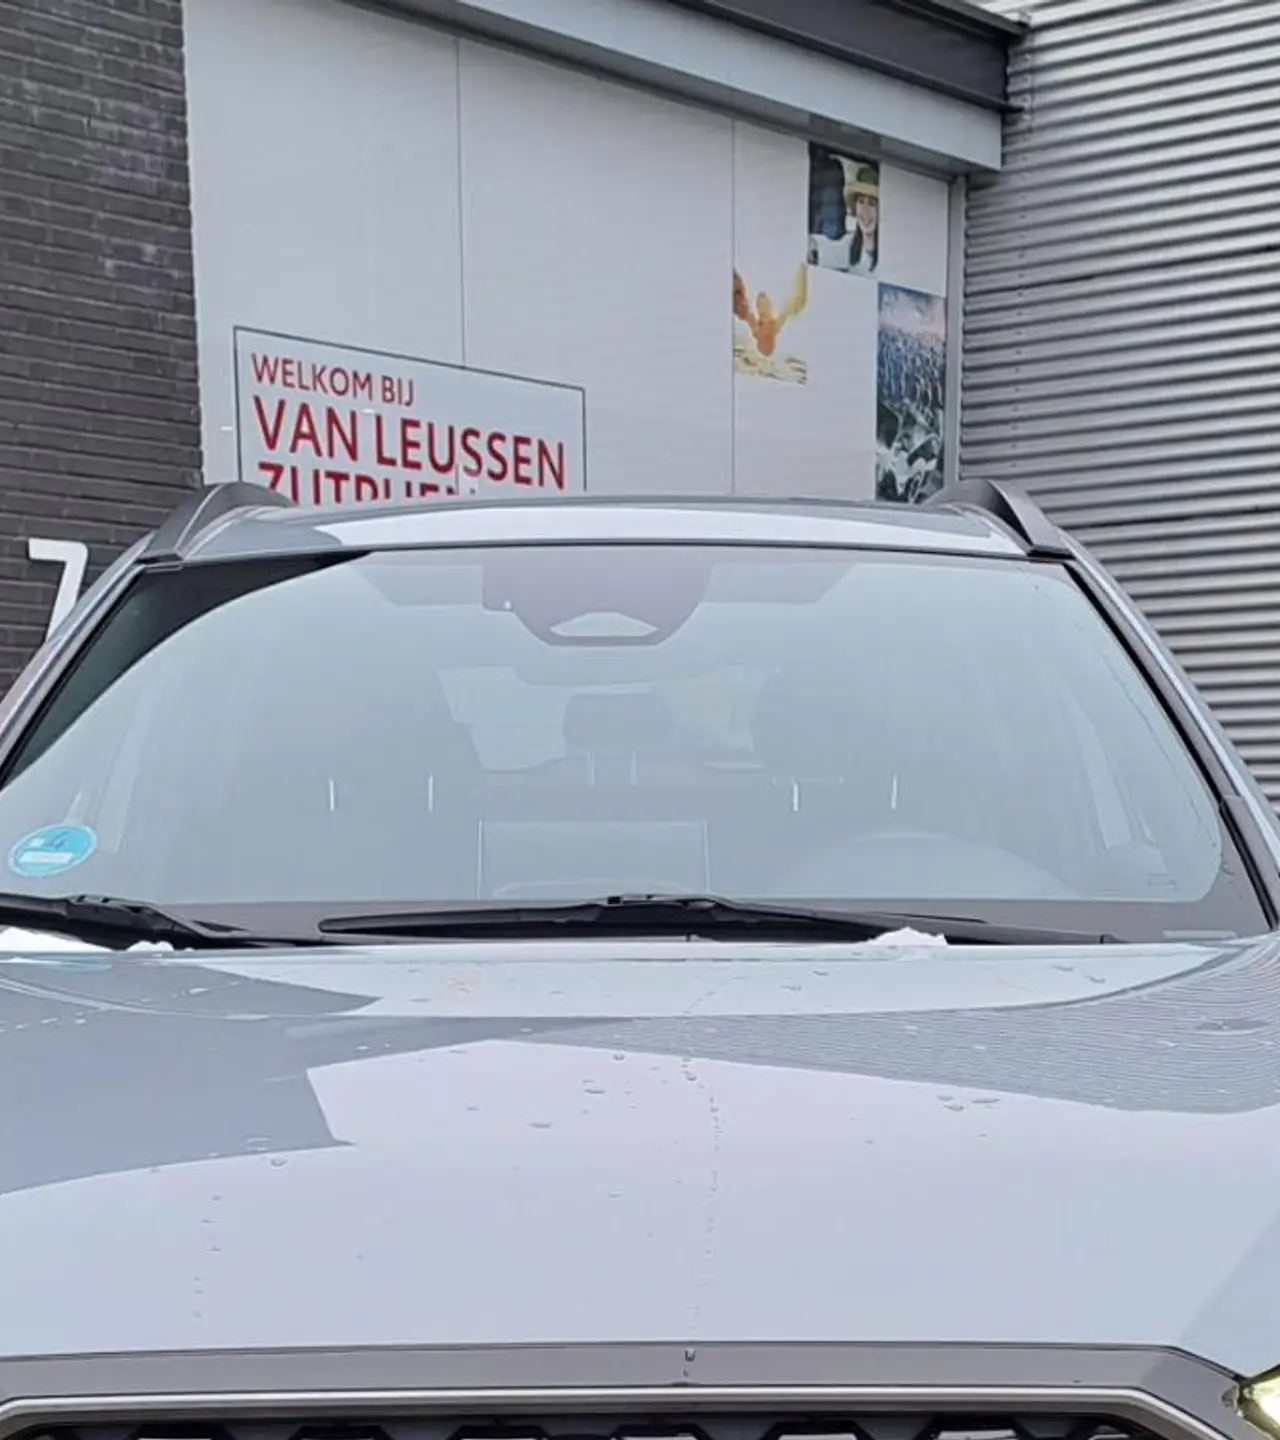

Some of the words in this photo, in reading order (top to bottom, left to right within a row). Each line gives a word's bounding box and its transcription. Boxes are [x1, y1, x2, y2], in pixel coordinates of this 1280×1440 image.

[251, 353, 372, 400] WELKOM
[381, 375, 414, 406] BIJ
[253, 395, 358, 462] VAN
[375, 413, 564, 491] LEUSSEN
[28, 538, 88, 642] 7
